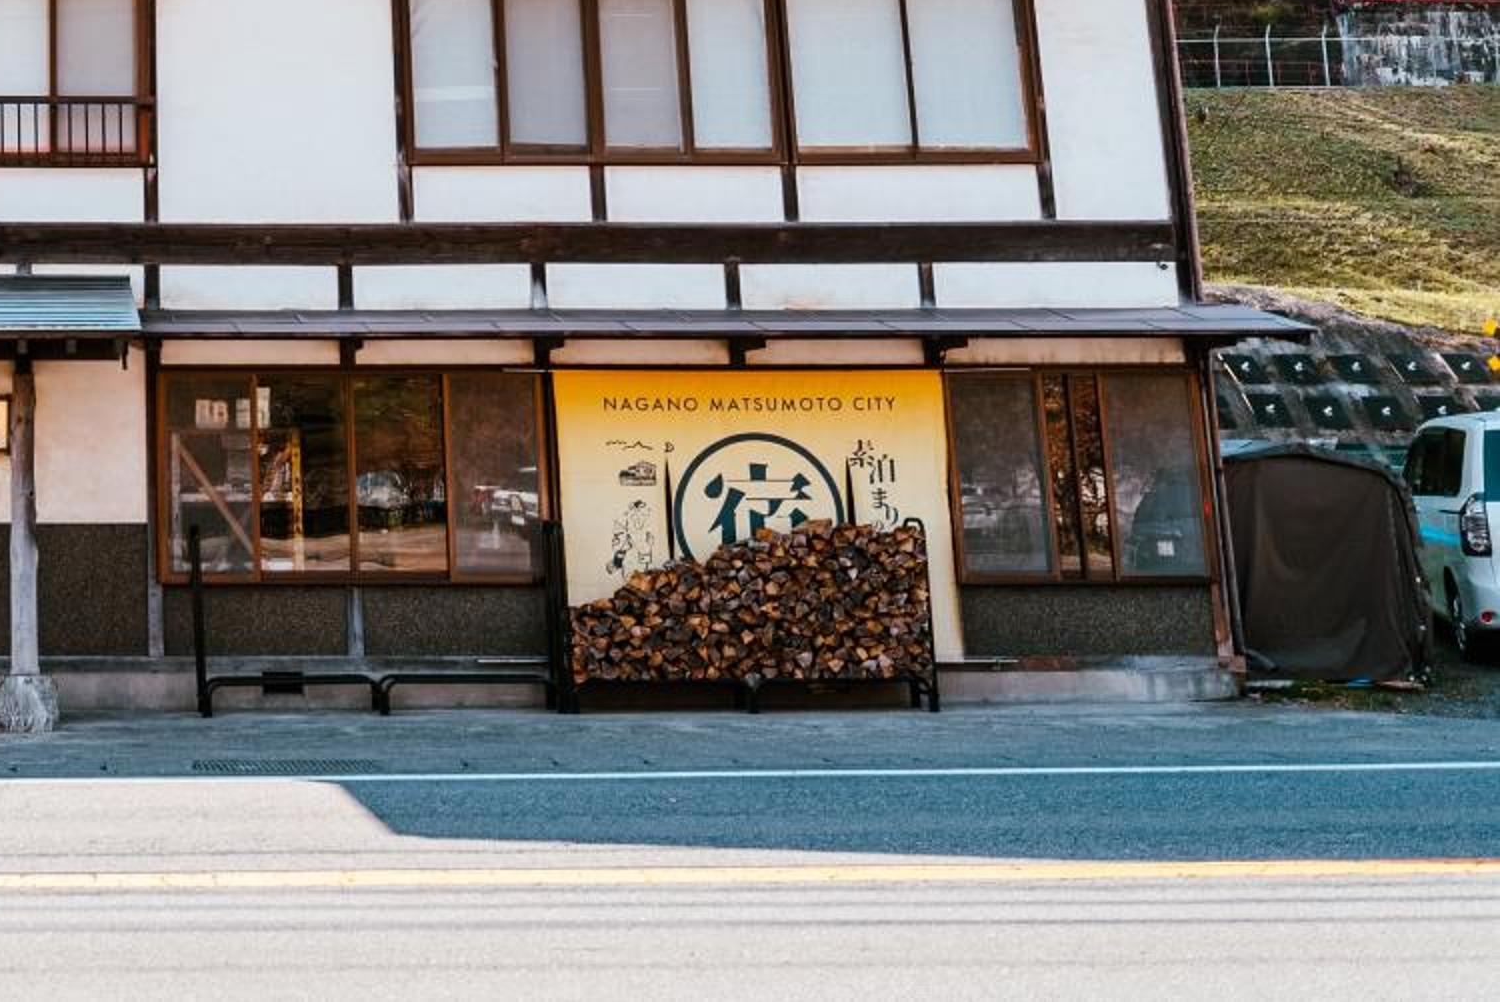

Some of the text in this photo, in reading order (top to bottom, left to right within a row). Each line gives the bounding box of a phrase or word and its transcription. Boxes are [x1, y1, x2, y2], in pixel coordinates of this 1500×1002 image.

[603, 397, 896, 412] NAGANO MATSUMOTO CITY
